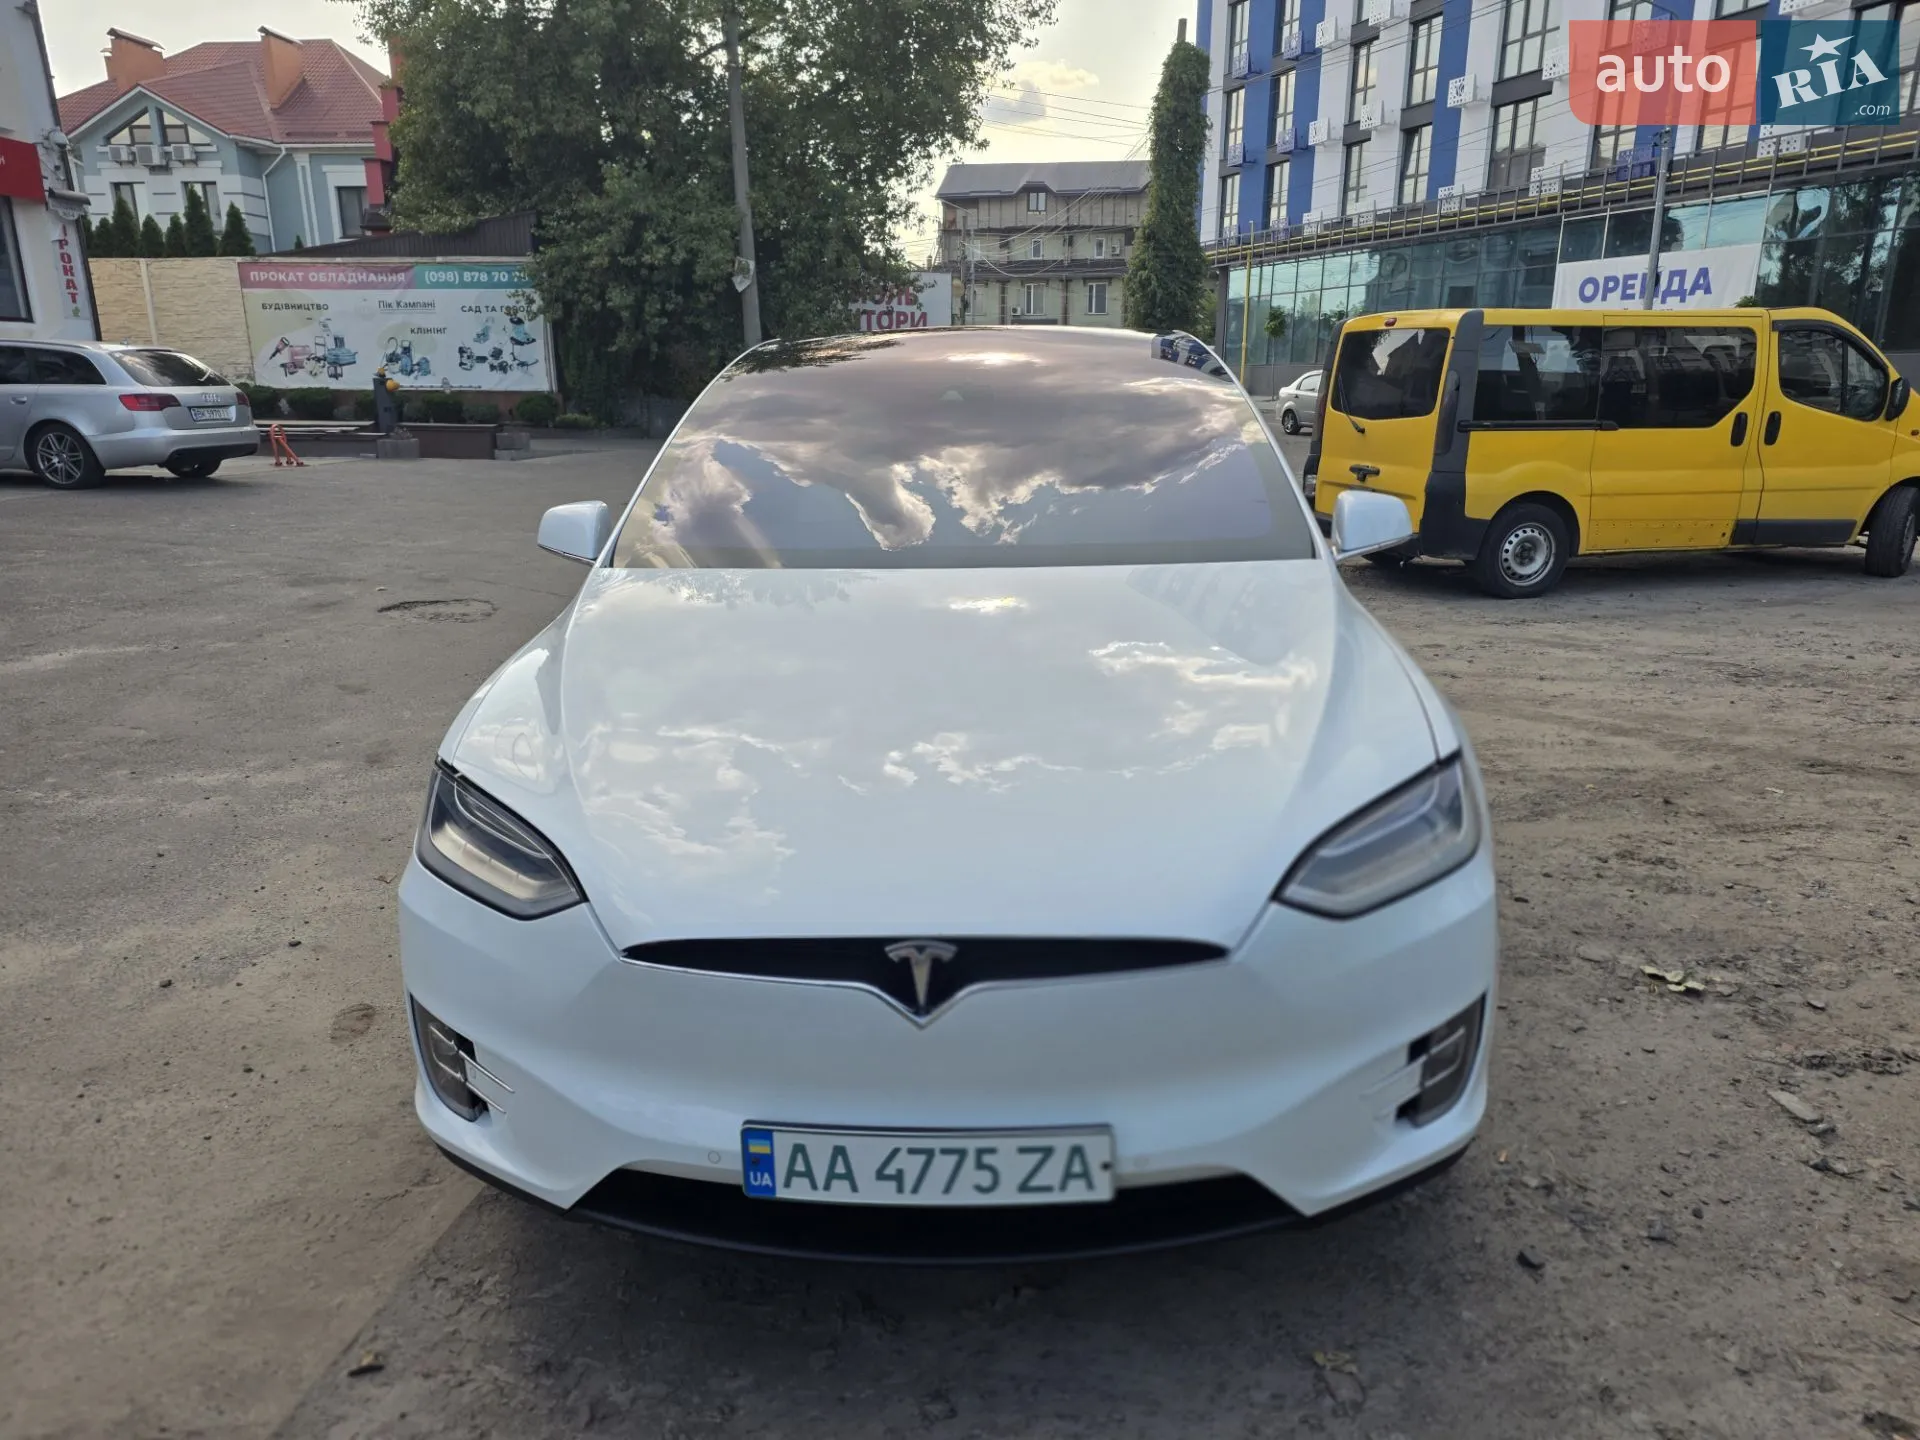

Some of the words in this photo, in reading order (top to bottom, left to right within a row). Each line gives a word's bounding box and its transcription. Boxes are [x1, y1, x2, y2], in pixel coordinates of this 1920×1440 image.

[250, 271, 305, 282] ПРОКАТ
[308, 271, 406, 284] ОБЛАДНАННЯ
[424, 271, 459, 284] (098)
[463, 271, 489, 283] 878
[494, 271, 509, 282] 70
[261, 302, 329, 311] БУДІВНИЦТВО
[378, 300, 393, 309] Пік
[460, 305, 482, 314] САД
[484, 305, 498, 313] ТА
[854, 310, 928, 332] ТОРИ
[410, 327, 447, 335] КЛІНІНГ
[783, 1142, 859, 1193] AA
[875, 1146, 999, 1195] 4775
[1017, 1145, 1095, 1193] ZA
[750, 1171, 773, 1188] UA
